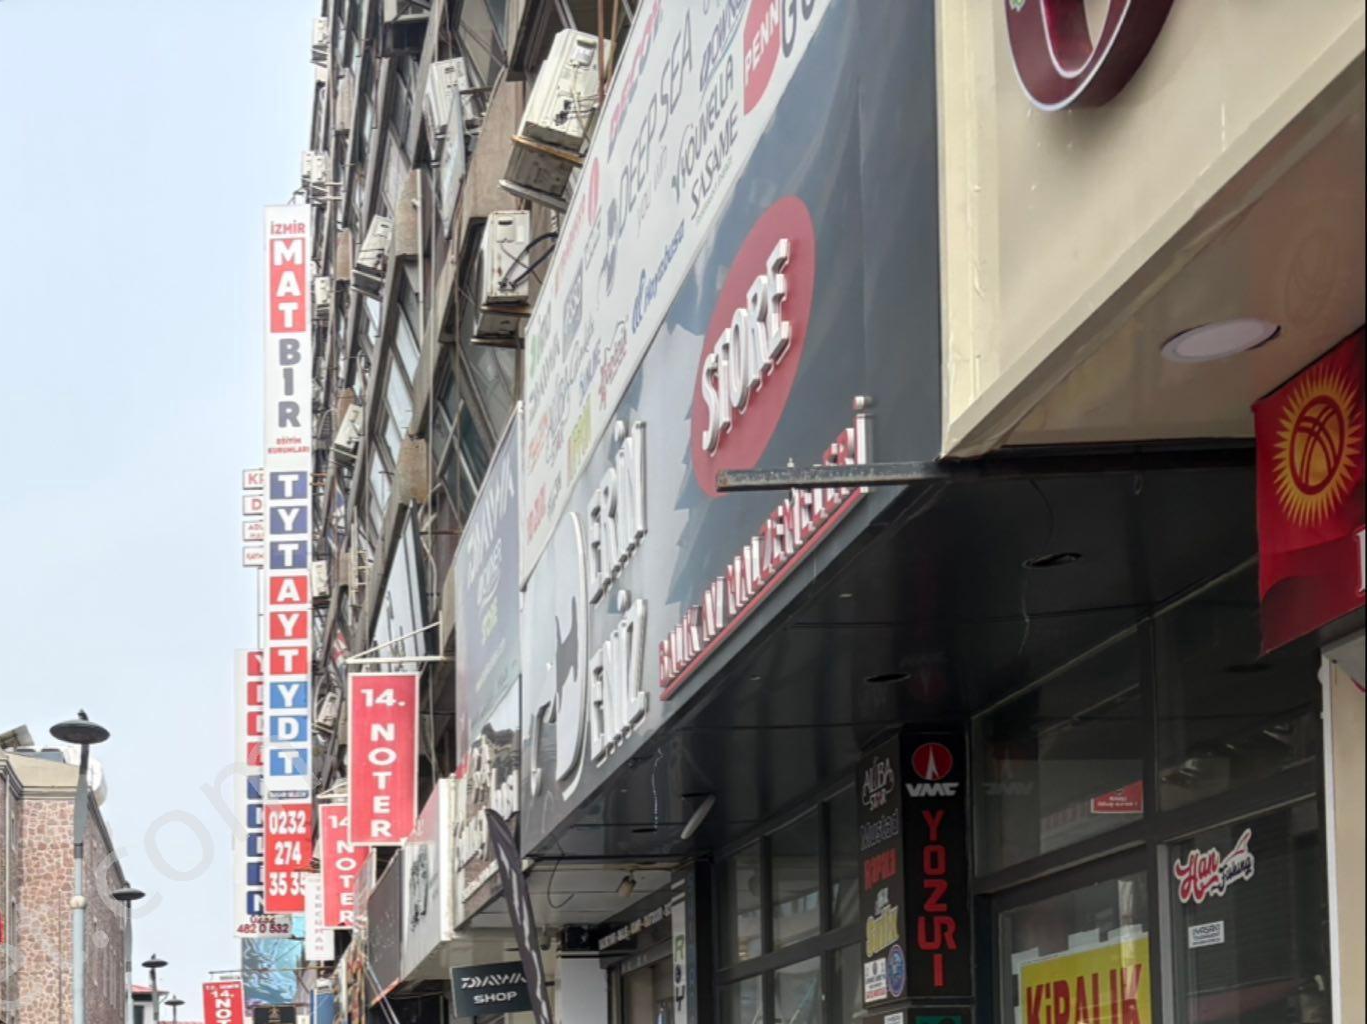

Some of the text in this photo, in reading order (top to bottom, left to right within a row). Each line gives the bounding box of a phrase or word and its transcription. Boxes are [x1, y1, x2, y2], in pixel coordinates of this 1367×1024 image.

[744, 3, 780, 88] PENN
[270, 220, 305, 234] İZMİR
[272, 239, 305, 330] MAT
[701, 237, 792, 457] STORE
[277, 473, 301, 568] TYT
[276, 577, 301, 671] AYT
[276, 683, 301, 775] YDT
[361, 688, 406, 707] 14.
[269, 810, 306, 835] 0232
[368, 723, 398, 838] NOTER
[269, 872, 287, 897] 35
[274, 841, 302, 865] 274
[333, 839, 358, 926] NOTER
[474, 991, 518, 1005] SHOP
